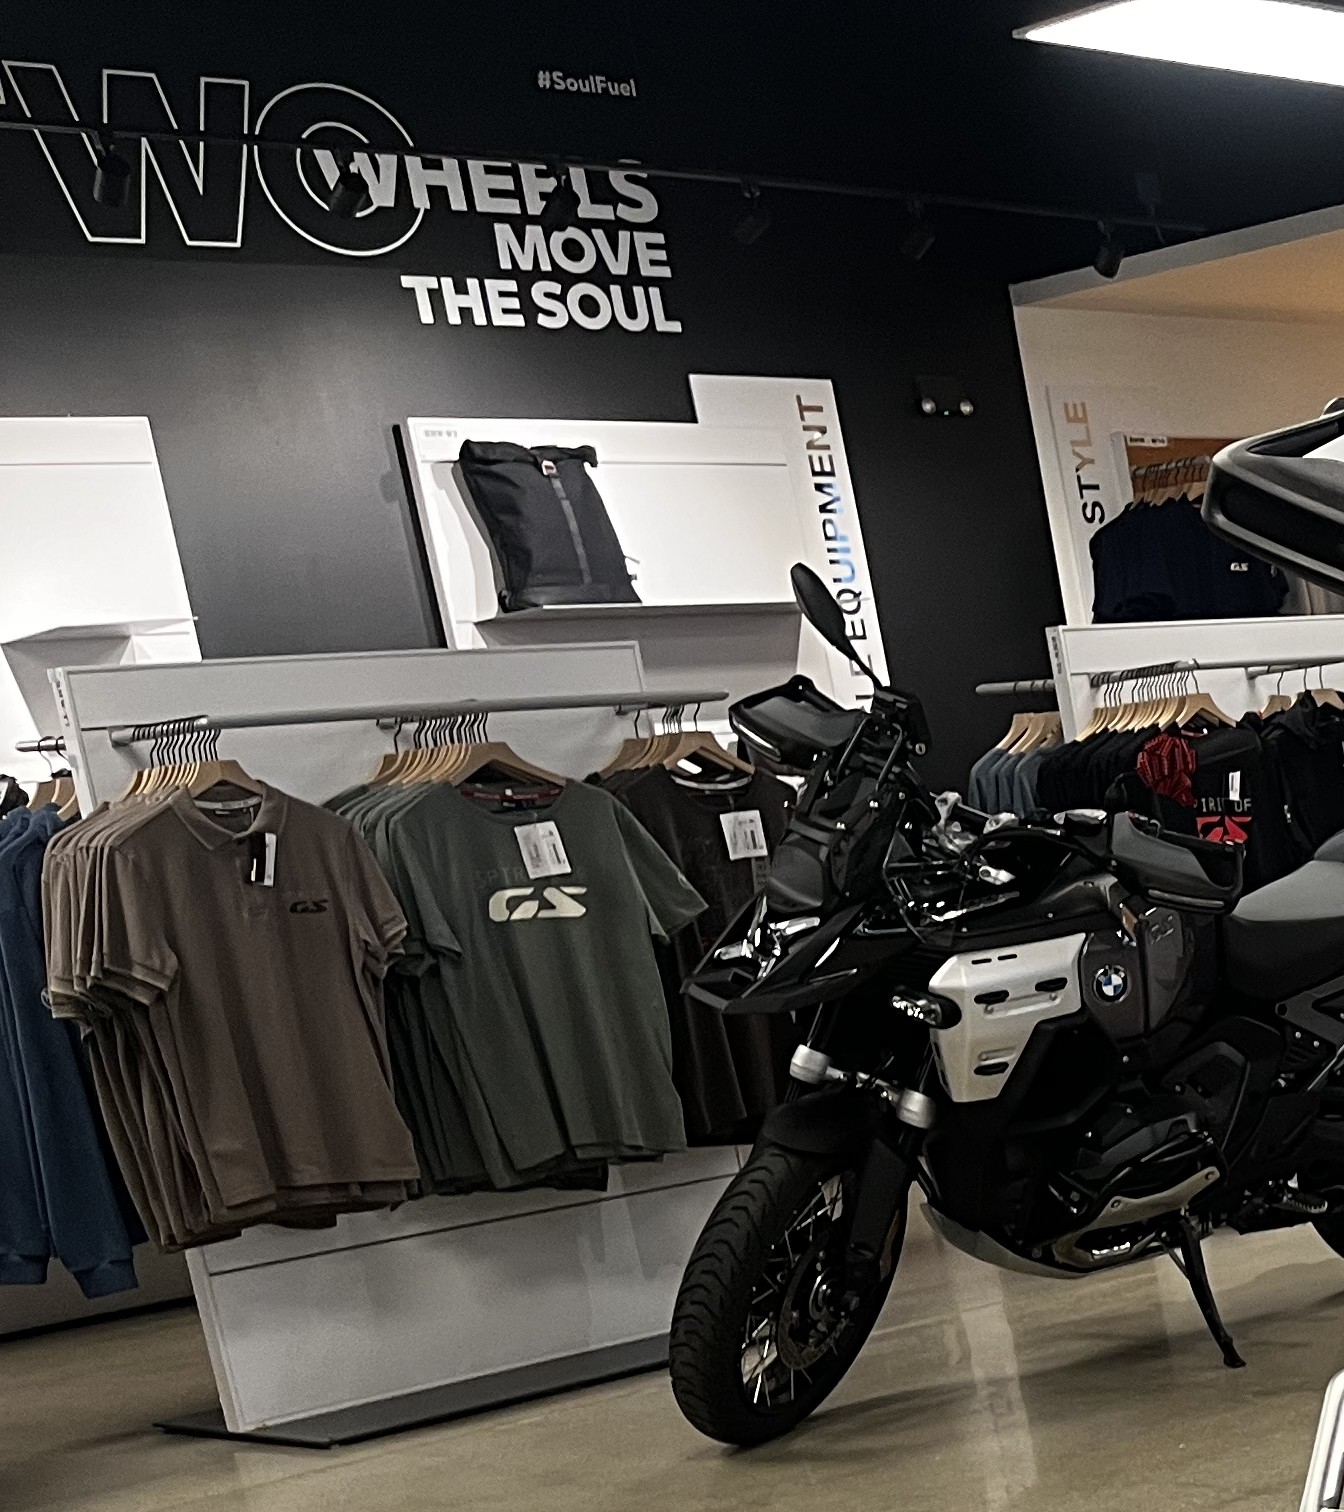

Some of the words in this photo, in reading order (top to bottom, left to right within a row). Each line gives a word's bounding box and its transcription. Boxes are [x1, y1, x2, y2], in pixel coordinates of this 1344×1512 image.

[538, 70, 637, 97] #SoulFuel
[0, 60, 424, 256] WO
[493, 222, 672, 278] MOVE
[401, 275, 525, 327] THE
[530, 280, 682, 333] SOUL
[1063, 401, 1105, 525] STYLE
[796, 394, 868, 641] EQUIPMENT
[289, 899, 329, 914] GS
[489, 886, 587, 923] GS
